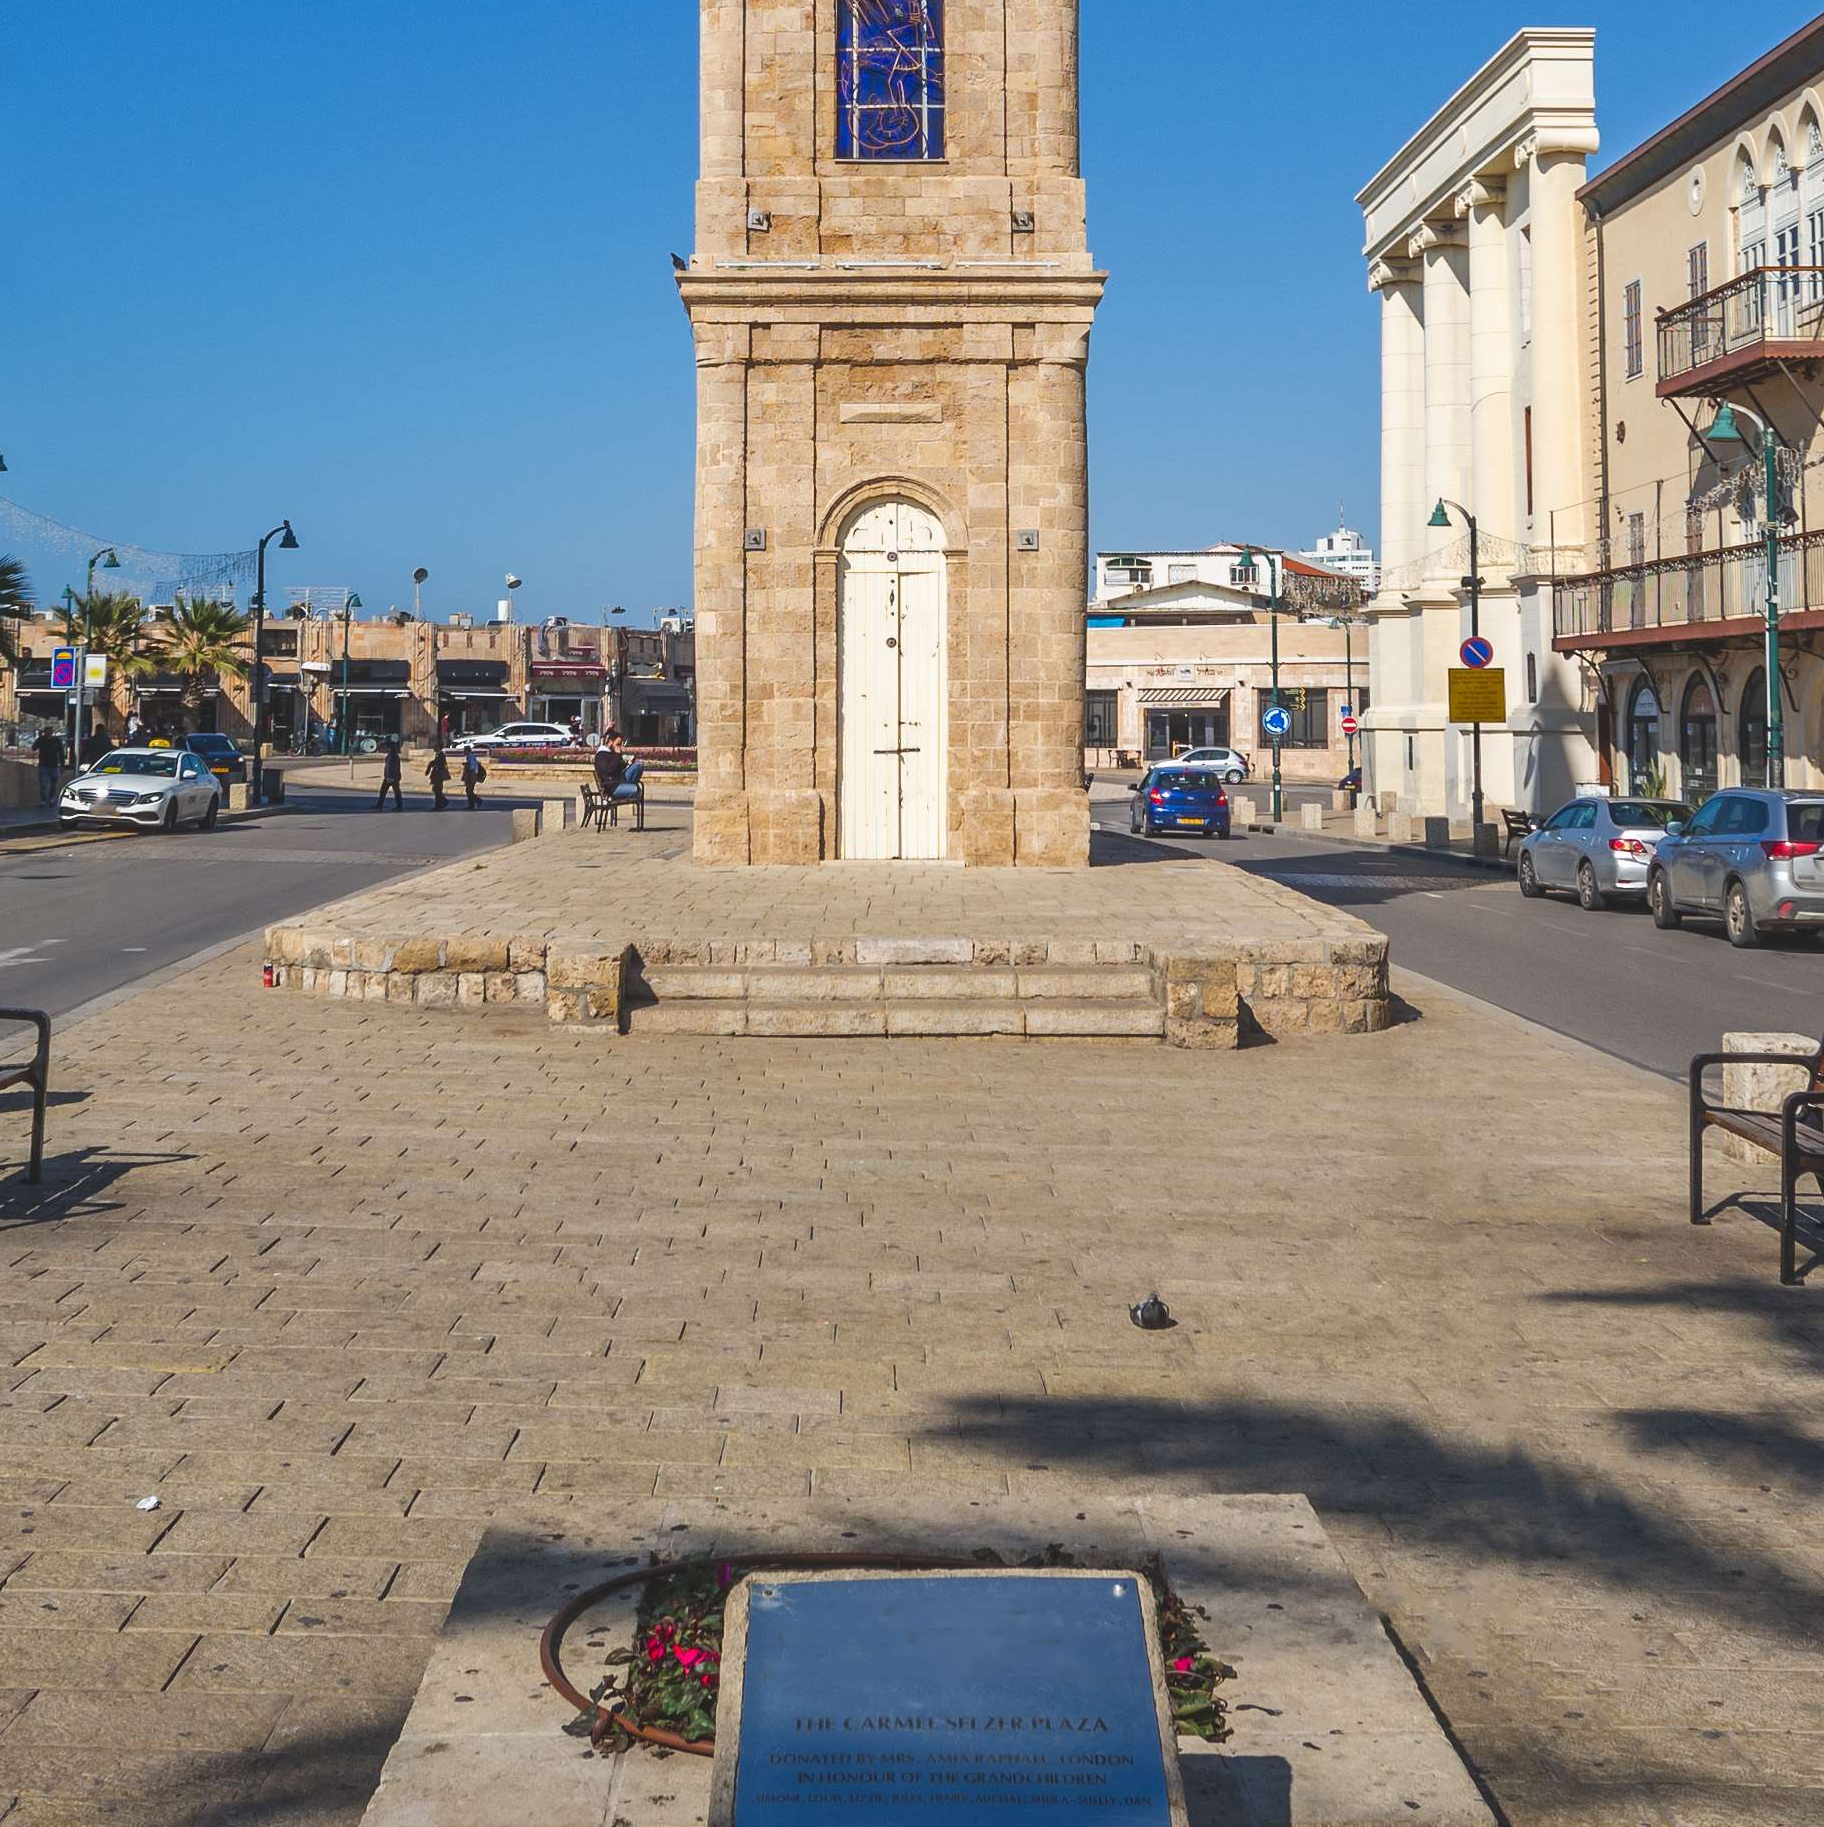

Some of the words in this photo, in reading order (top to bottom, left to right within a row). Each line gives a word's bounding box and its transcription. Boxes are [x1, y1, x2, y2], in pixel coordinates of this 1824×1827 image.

[795, 1716, 835, 1732] THE
[843, 1716, 937, 1732] CARMEL
[1031, 1716, 1110, 1732] PLAZA
[769, 1752, 851, 1765] DONATED
[856, 1753, 877, 1765] BY
[880, 1753, 920, 1765] MRS.
[1060, 1754, 1134, 1766] LONDON
[797, 1772, 815, 1784] IN
[819, 1772, 896, 1784] HONOUR
[901, 1772, 922, 1784] OF
[929, 1772, 958, 1784] THE
[964, 1772, 1107, 1785] GRANDCHILDREN
